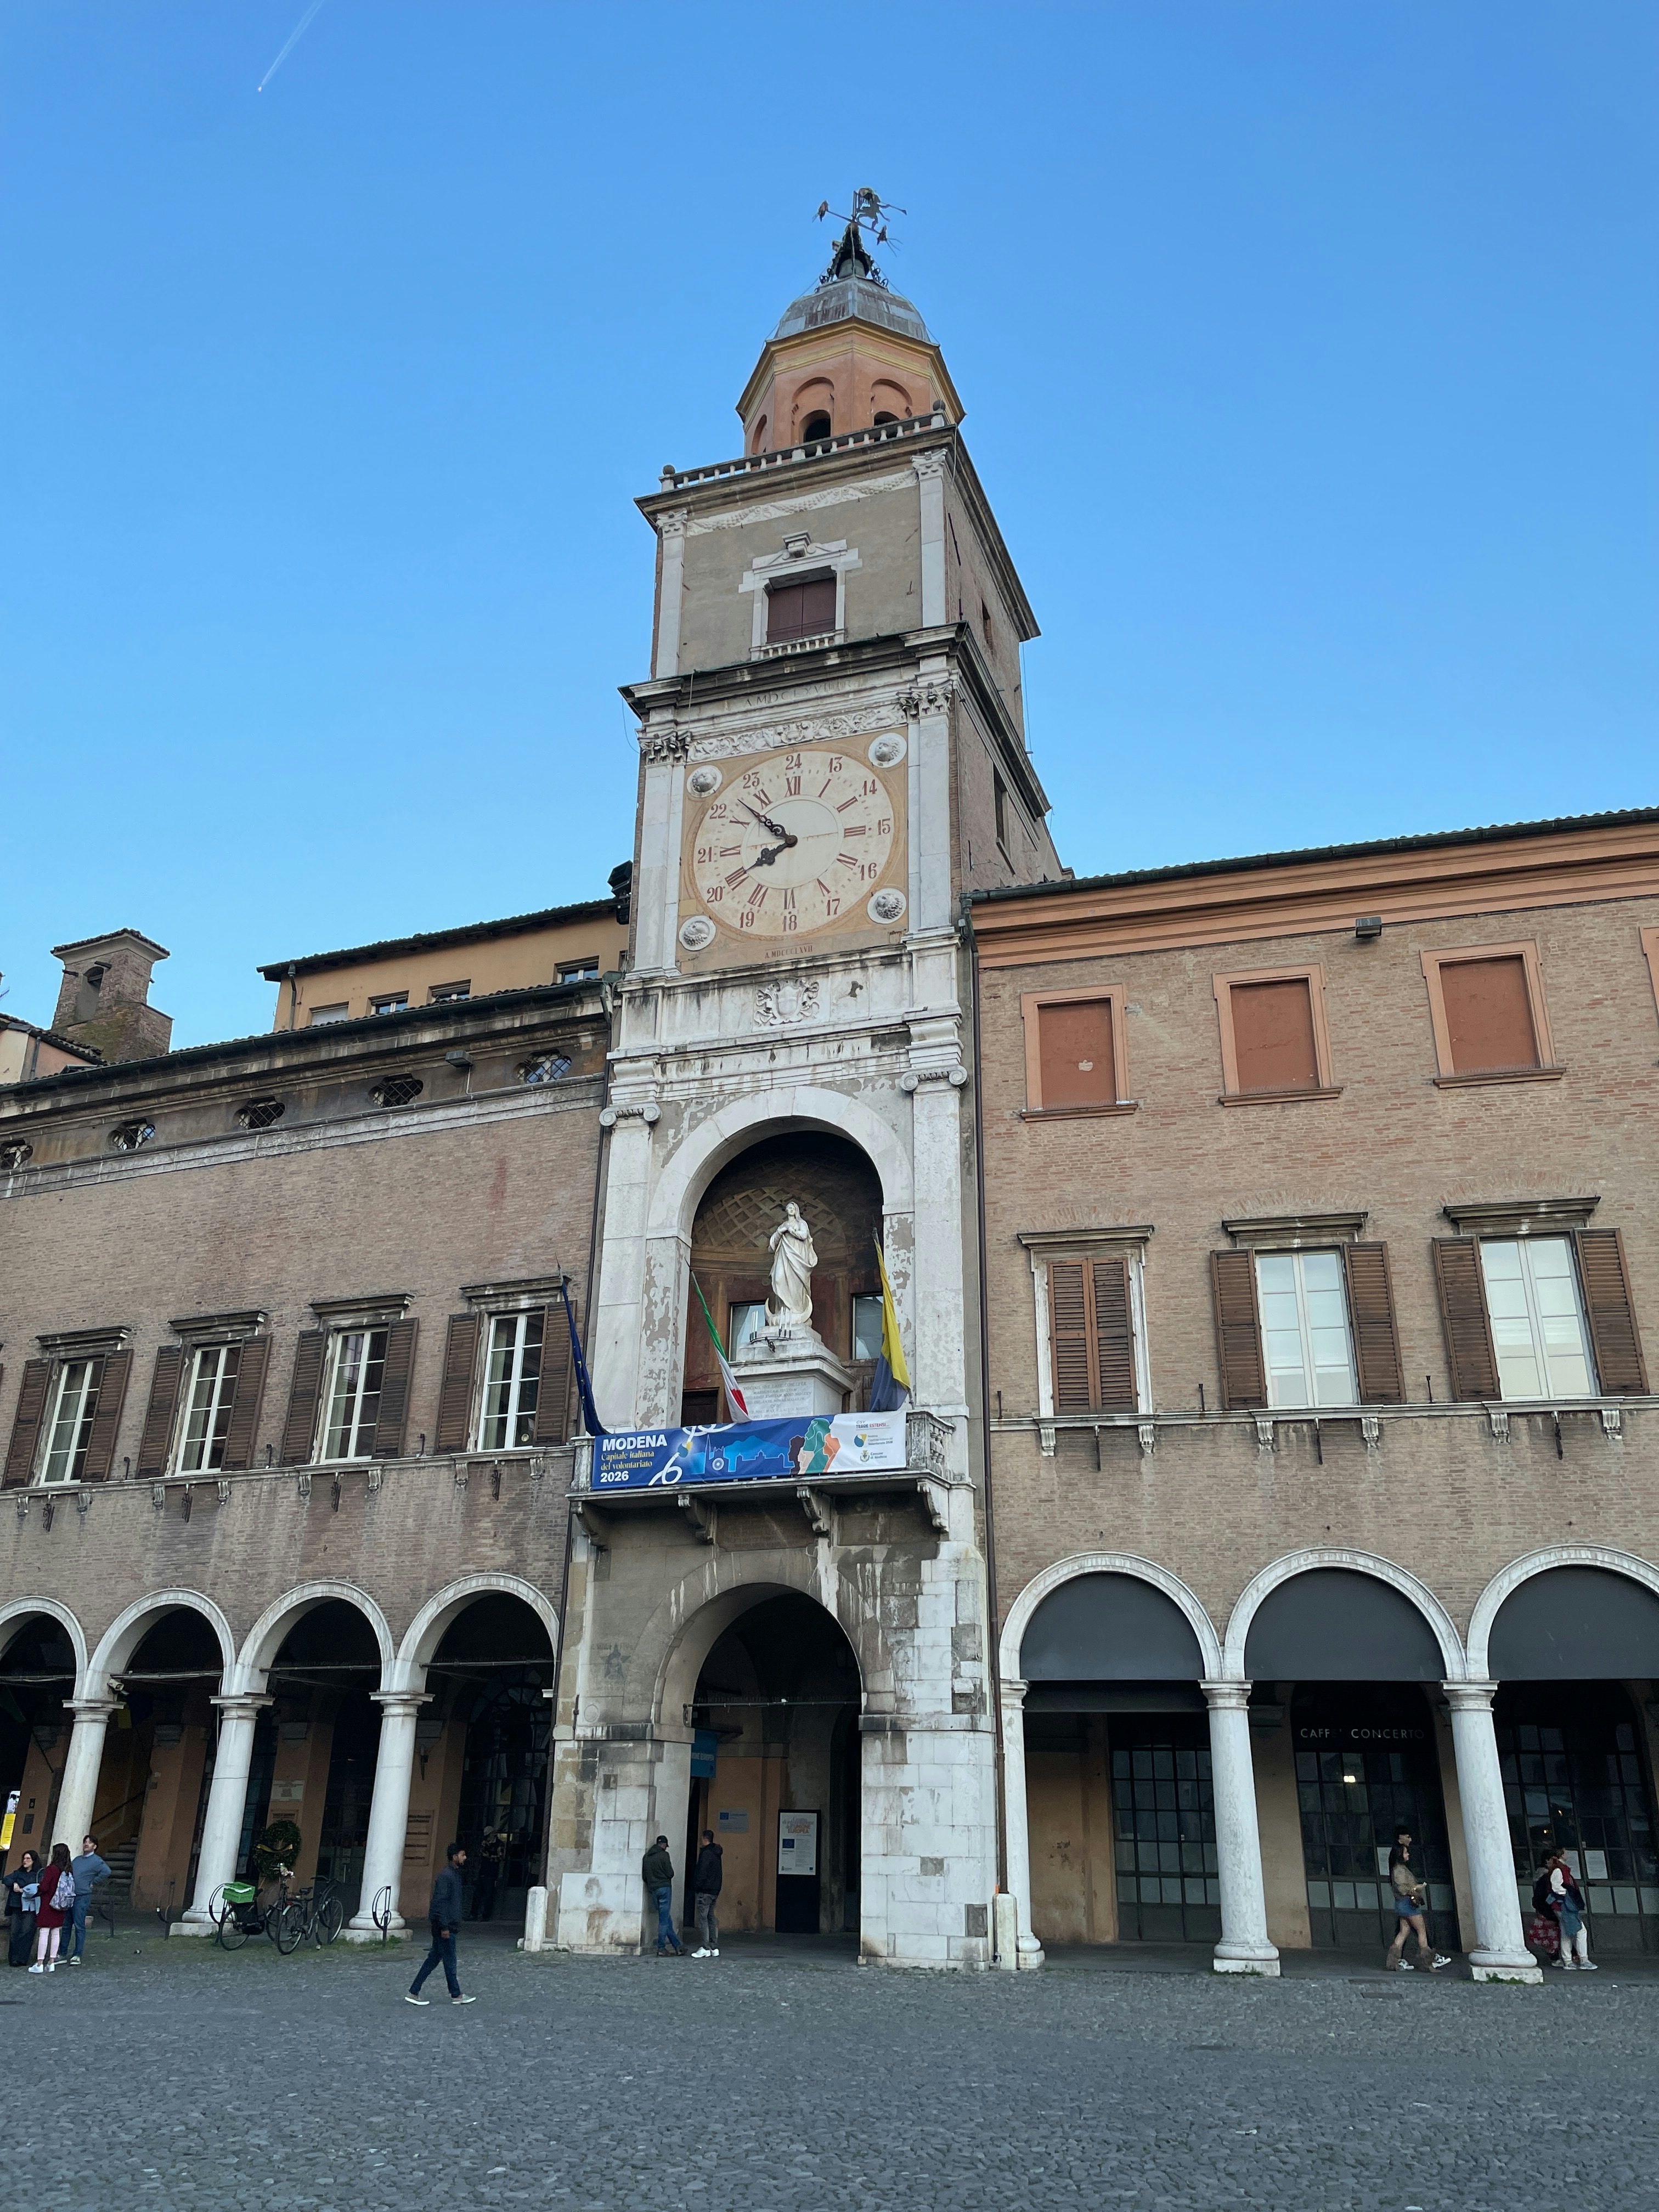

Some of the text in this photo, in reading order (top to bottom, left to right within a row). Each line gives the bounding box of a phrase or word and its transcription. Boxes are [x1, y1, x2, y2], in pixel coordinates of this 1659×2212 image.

[786, 754, 802, 770] 24
[828, 757, 843, 773] 13
[743, 772, 760, 789] 23
[785, 776, 801, 798] XII
[819, 778, 831, 797] I
[862, 780, 877, 795] 14
[753, 789, 773, 810] XI
[837, 796, 858, 813] II
[709, 804, 727, 819] 22
[729, 816, 751, 829] X
[878, 819, 891, 836] 15
[844, 825, 866, 838] III
[698, 847, 712, 864] 21
[720, 844, 741, 857] IX
[836, 853, 858, 871] IV
[725, 866, 749, 891] VIII
[860, 862, 877, 881] 16
[707, 886, 723, 903] 20
[747, 883, 768, 907] VII
[817, 878, 831, 896] V
[826, 898, 840, 916] 17
[740, 912, 754, 928] 19
[782, 915, 797, 932] 18
[602, 1434, 667, 1452] MODENA
[601, 1450, 654, 1462] Capitale italiana
[601, 1460, 653, 1471] del volontariato
[600, 1470, 629, 1483] 2026
[1351, 1729, 1425, 1739] CONCERTO
